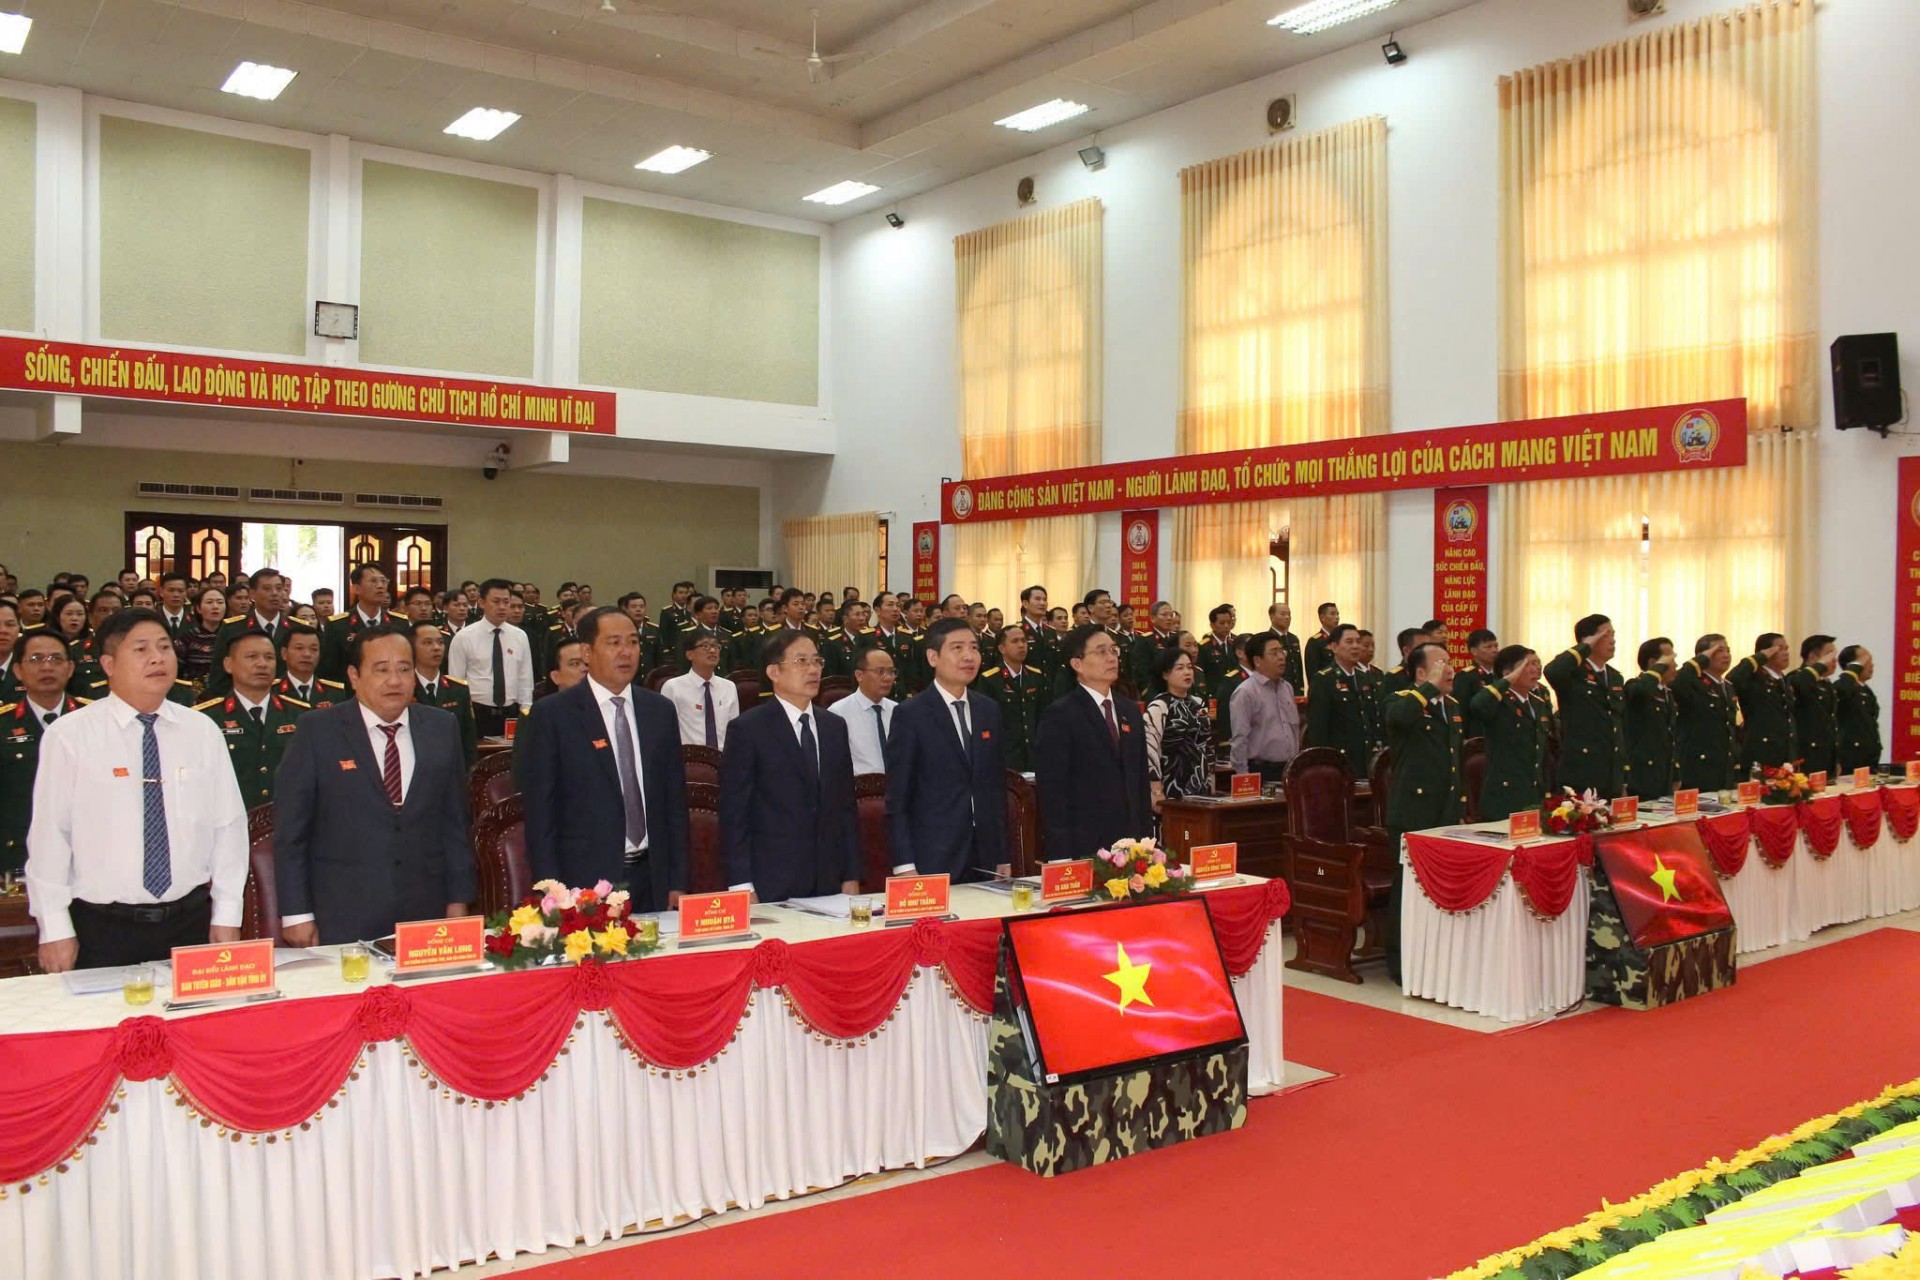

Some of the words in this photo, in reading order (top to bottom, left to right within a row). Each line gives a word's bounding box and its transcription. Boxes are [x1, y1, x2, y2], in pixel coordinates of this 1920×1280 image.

[25, 344, 75, 388] SỐNG,
[80, 350, 130, 388] CHIẾN
[134, 355, 169, 395] ĐẤU,
[173, 365, 201, 394] LAO
[205, 363, 245, 402] ĐỘNG
[249, 367, 269, 400] VÀ
[272, 373, 300, 407] HỌC
[304, 372, 330, 409] TẬP
[334, 379, 368, 408] THEO
[372, 380, 416, 411] GƯƠNG
[420, 381, 445, 414] CHỦ
[449, 389, 477, 421] TỊCH
[480, 384, 498, 418] HỒ
[500, 389, 521, 420] CHÍ
[525, 395, 557, 423] MINH
[560, 394, 572, 424] VĨ
[575, 400, 595, 430] ĐẠI
[978, 485, 1004, 511] ĐẢNG
[1007, 485, 1034, 514] CỘNG
[1038, 479, 1060, 507] SẢN
[1062, 479, 1085, 508] VIỆT
[1088, 479, 1114, 501] NAM
[1126, 470, 1162, 499] NGƯỜI
[1165, 467, 1198, 495] LÃNH
[1201, 468, 1230, 496] ĐẠO,
[1234, 456, 1252, 489] TỔ
[1254, 457, 1290, 488] CHỨC
[1295, 458, 1323, 489] MỌI
[1327, 448, 1377, 481] THẮNG
[1382, 447, 1406, 482] LỢI
[1411, 440, 1445, 474] CỦA
[1449, 438, 1495, 472] CÁCH
[1501, 436, 1556, 472] MẠNG
[1562, 427, 1604, 467] VIỆT
[1610, 427, 1658, 460] NAM
[1463, 548, 1476, 557] CAO
[1436, 560, 1448, 571] SỨC
[1449, 560, 1468, 571] CHIẾN
[1463, 576, 1476, 586] LỰC
[1460, 615, 1473, 626] CẤP
[455, 944, 473, 953] LONG
